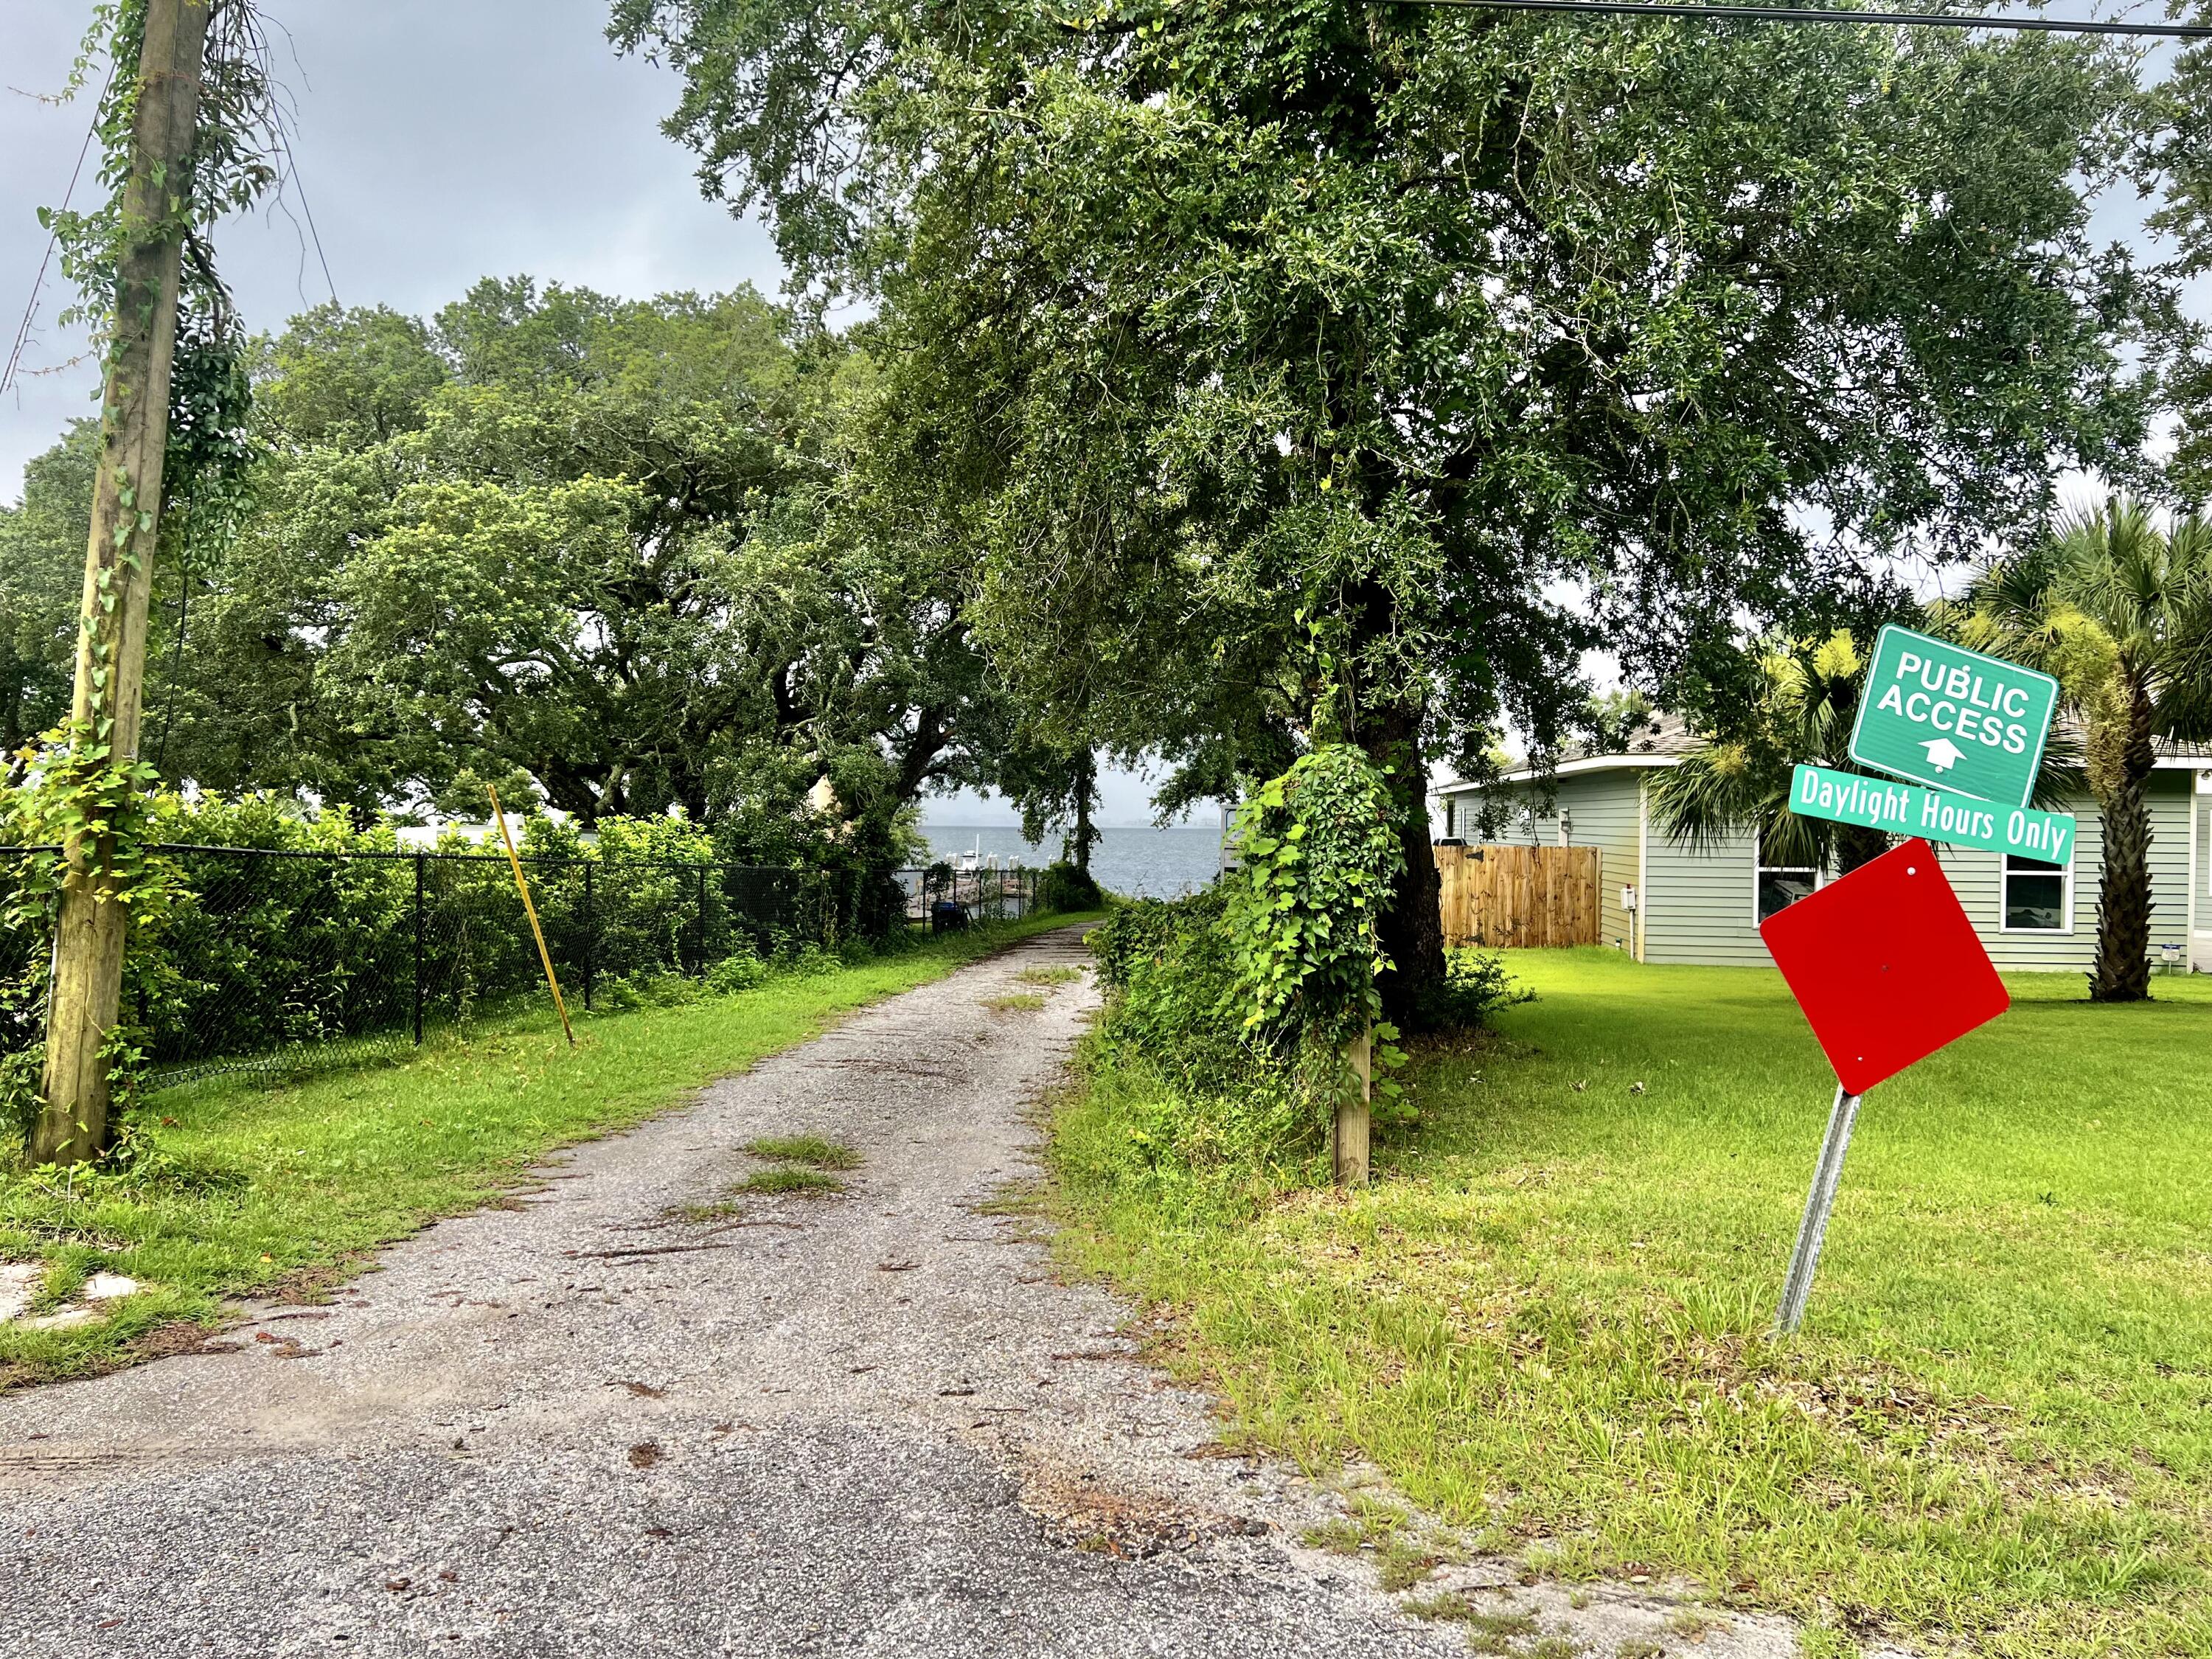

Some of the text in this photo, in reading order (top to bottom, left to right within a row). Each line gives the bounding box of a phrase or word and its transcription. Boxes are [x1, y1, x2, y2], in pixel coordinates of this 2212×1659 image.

[1877, 685, 2028, 754] ACCESS
[1896, 652, 2029, 718] PUBLIC
[1801, 771, 2067, 860] Daylight Hours Only
